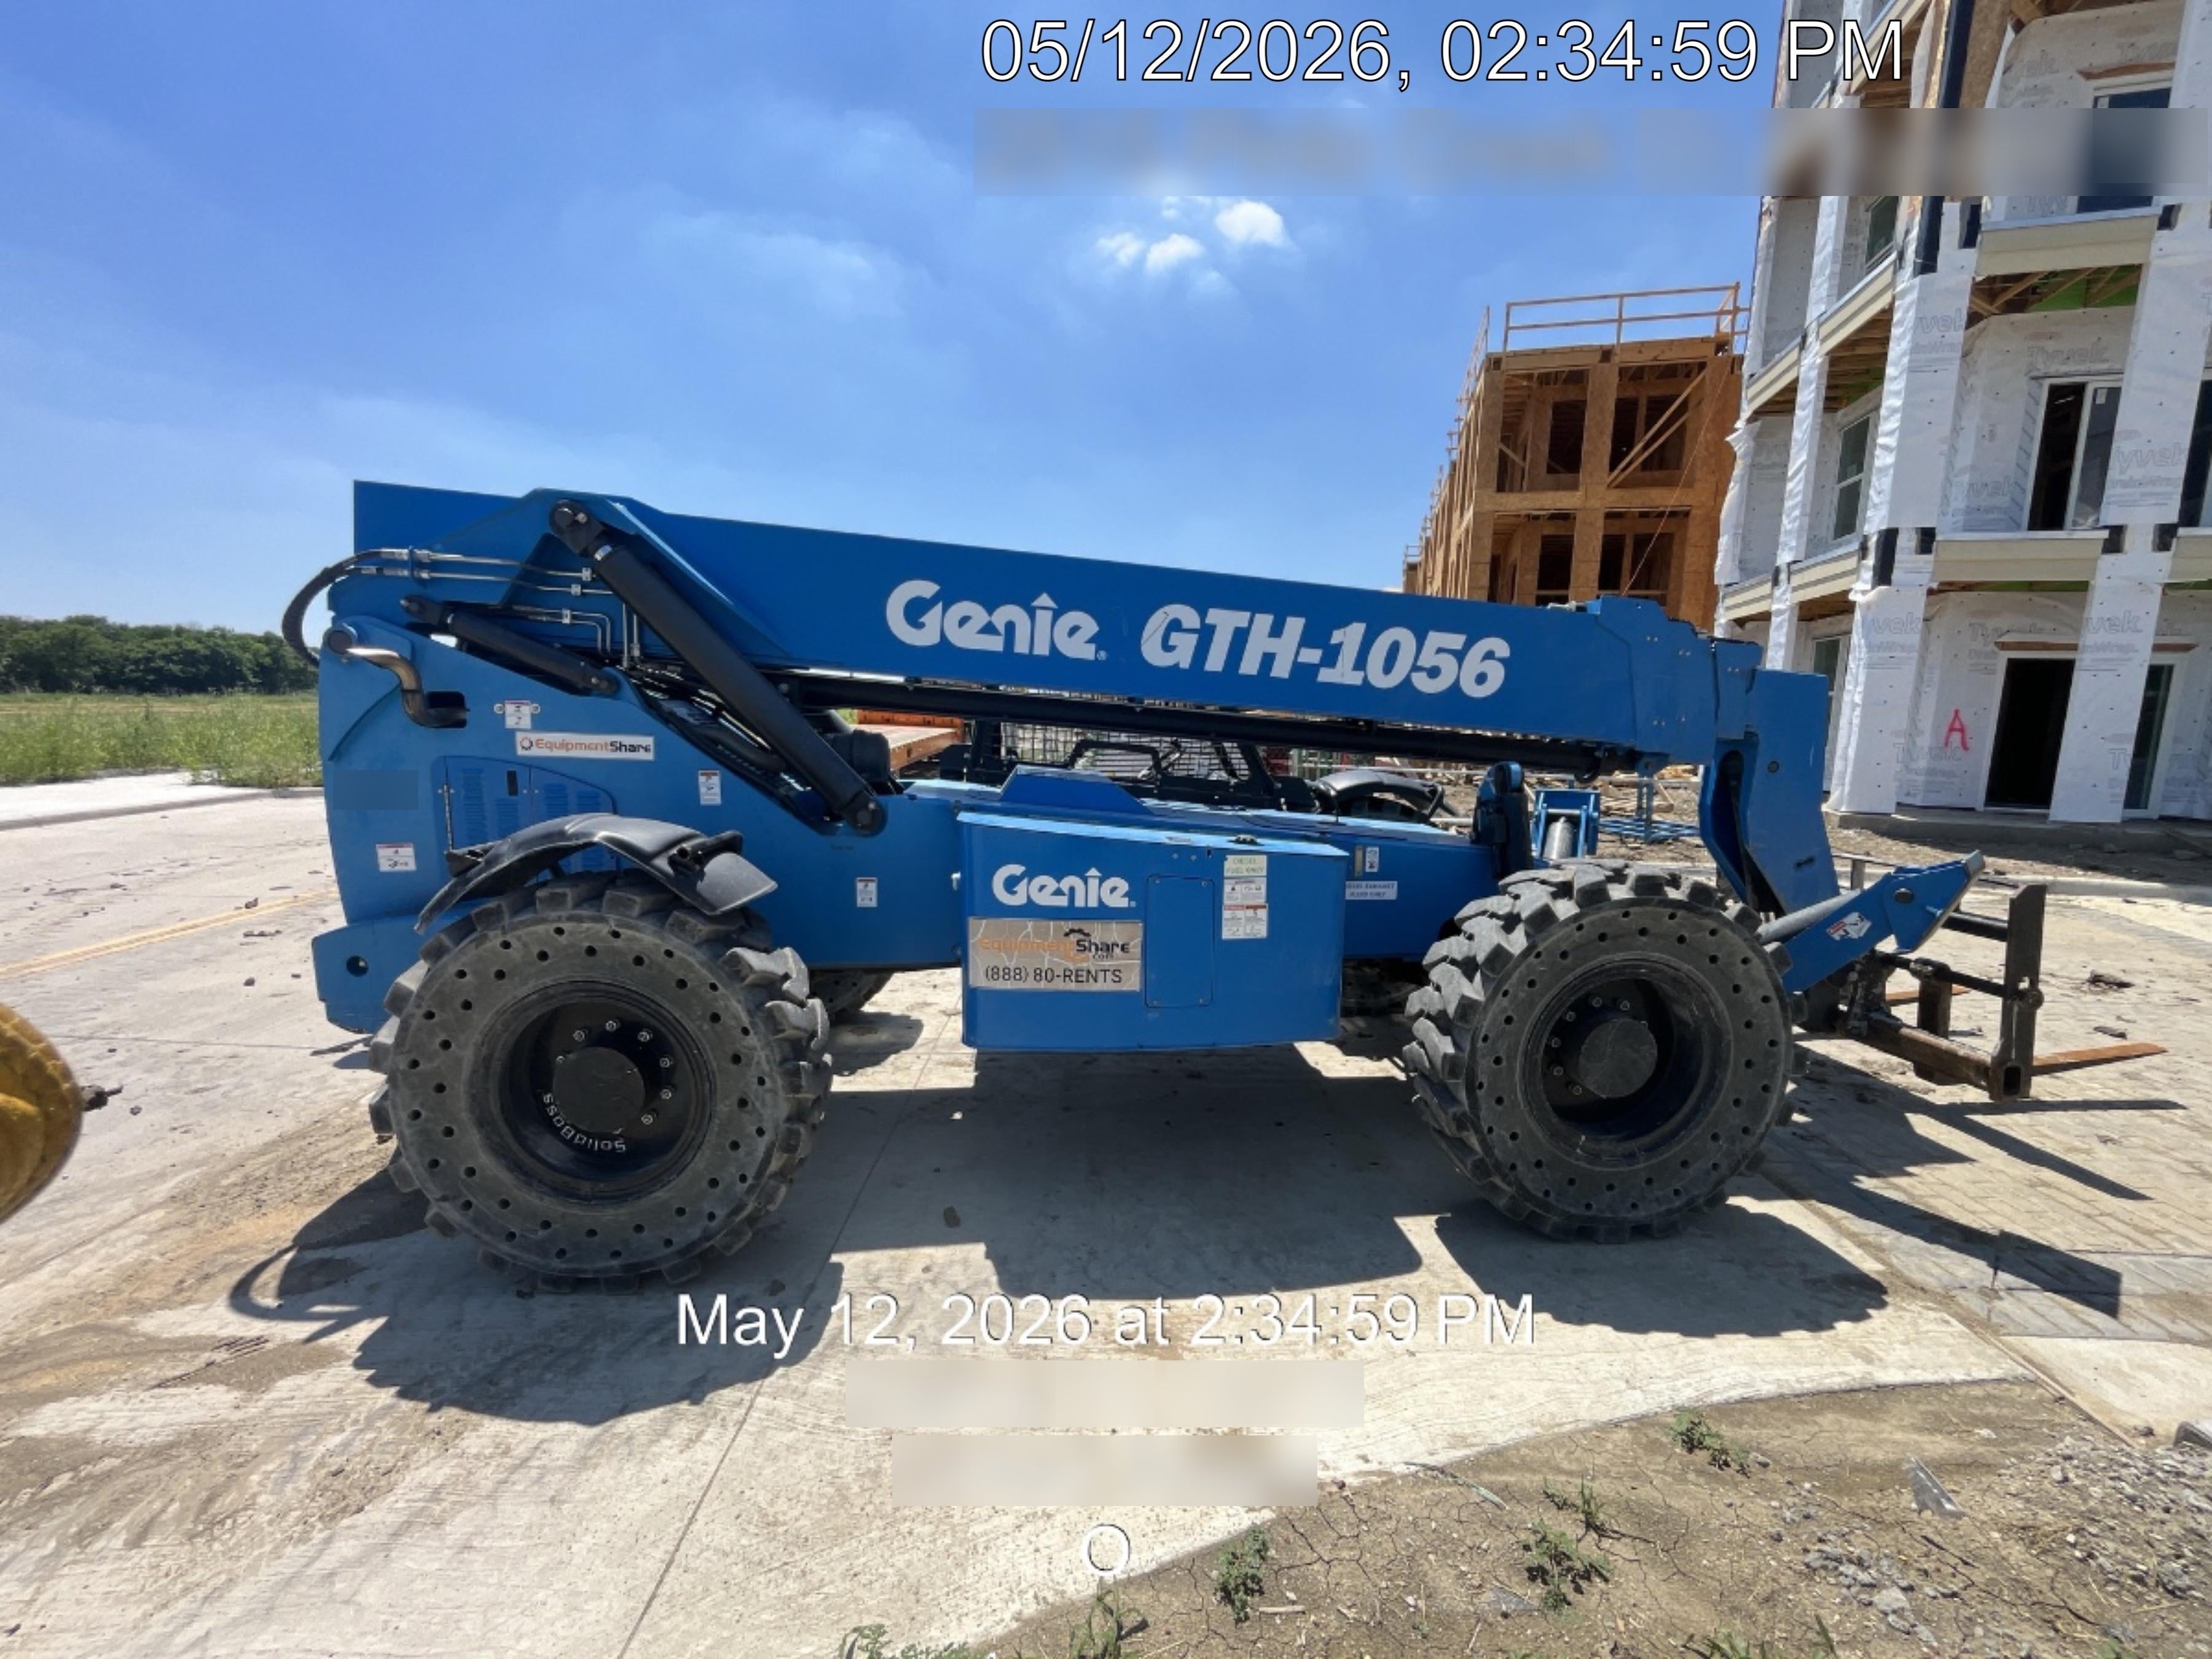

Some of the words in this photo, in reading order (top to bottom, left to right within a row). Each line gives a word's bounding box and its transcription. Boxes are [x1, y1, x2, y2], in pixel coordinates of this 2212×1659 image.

[885, 579, 1102, 661] Genie
[1140, 603, 1510, 698] GTH-1056
[535, 738, 651, 753] EquipmentShare
[1943, 708, 1970, 751] A
[992, 863, 1129, 908] Genie
[986, 965, 1029, 982] (888)
[1033, 967, 1122, 984] 80-RENTS
